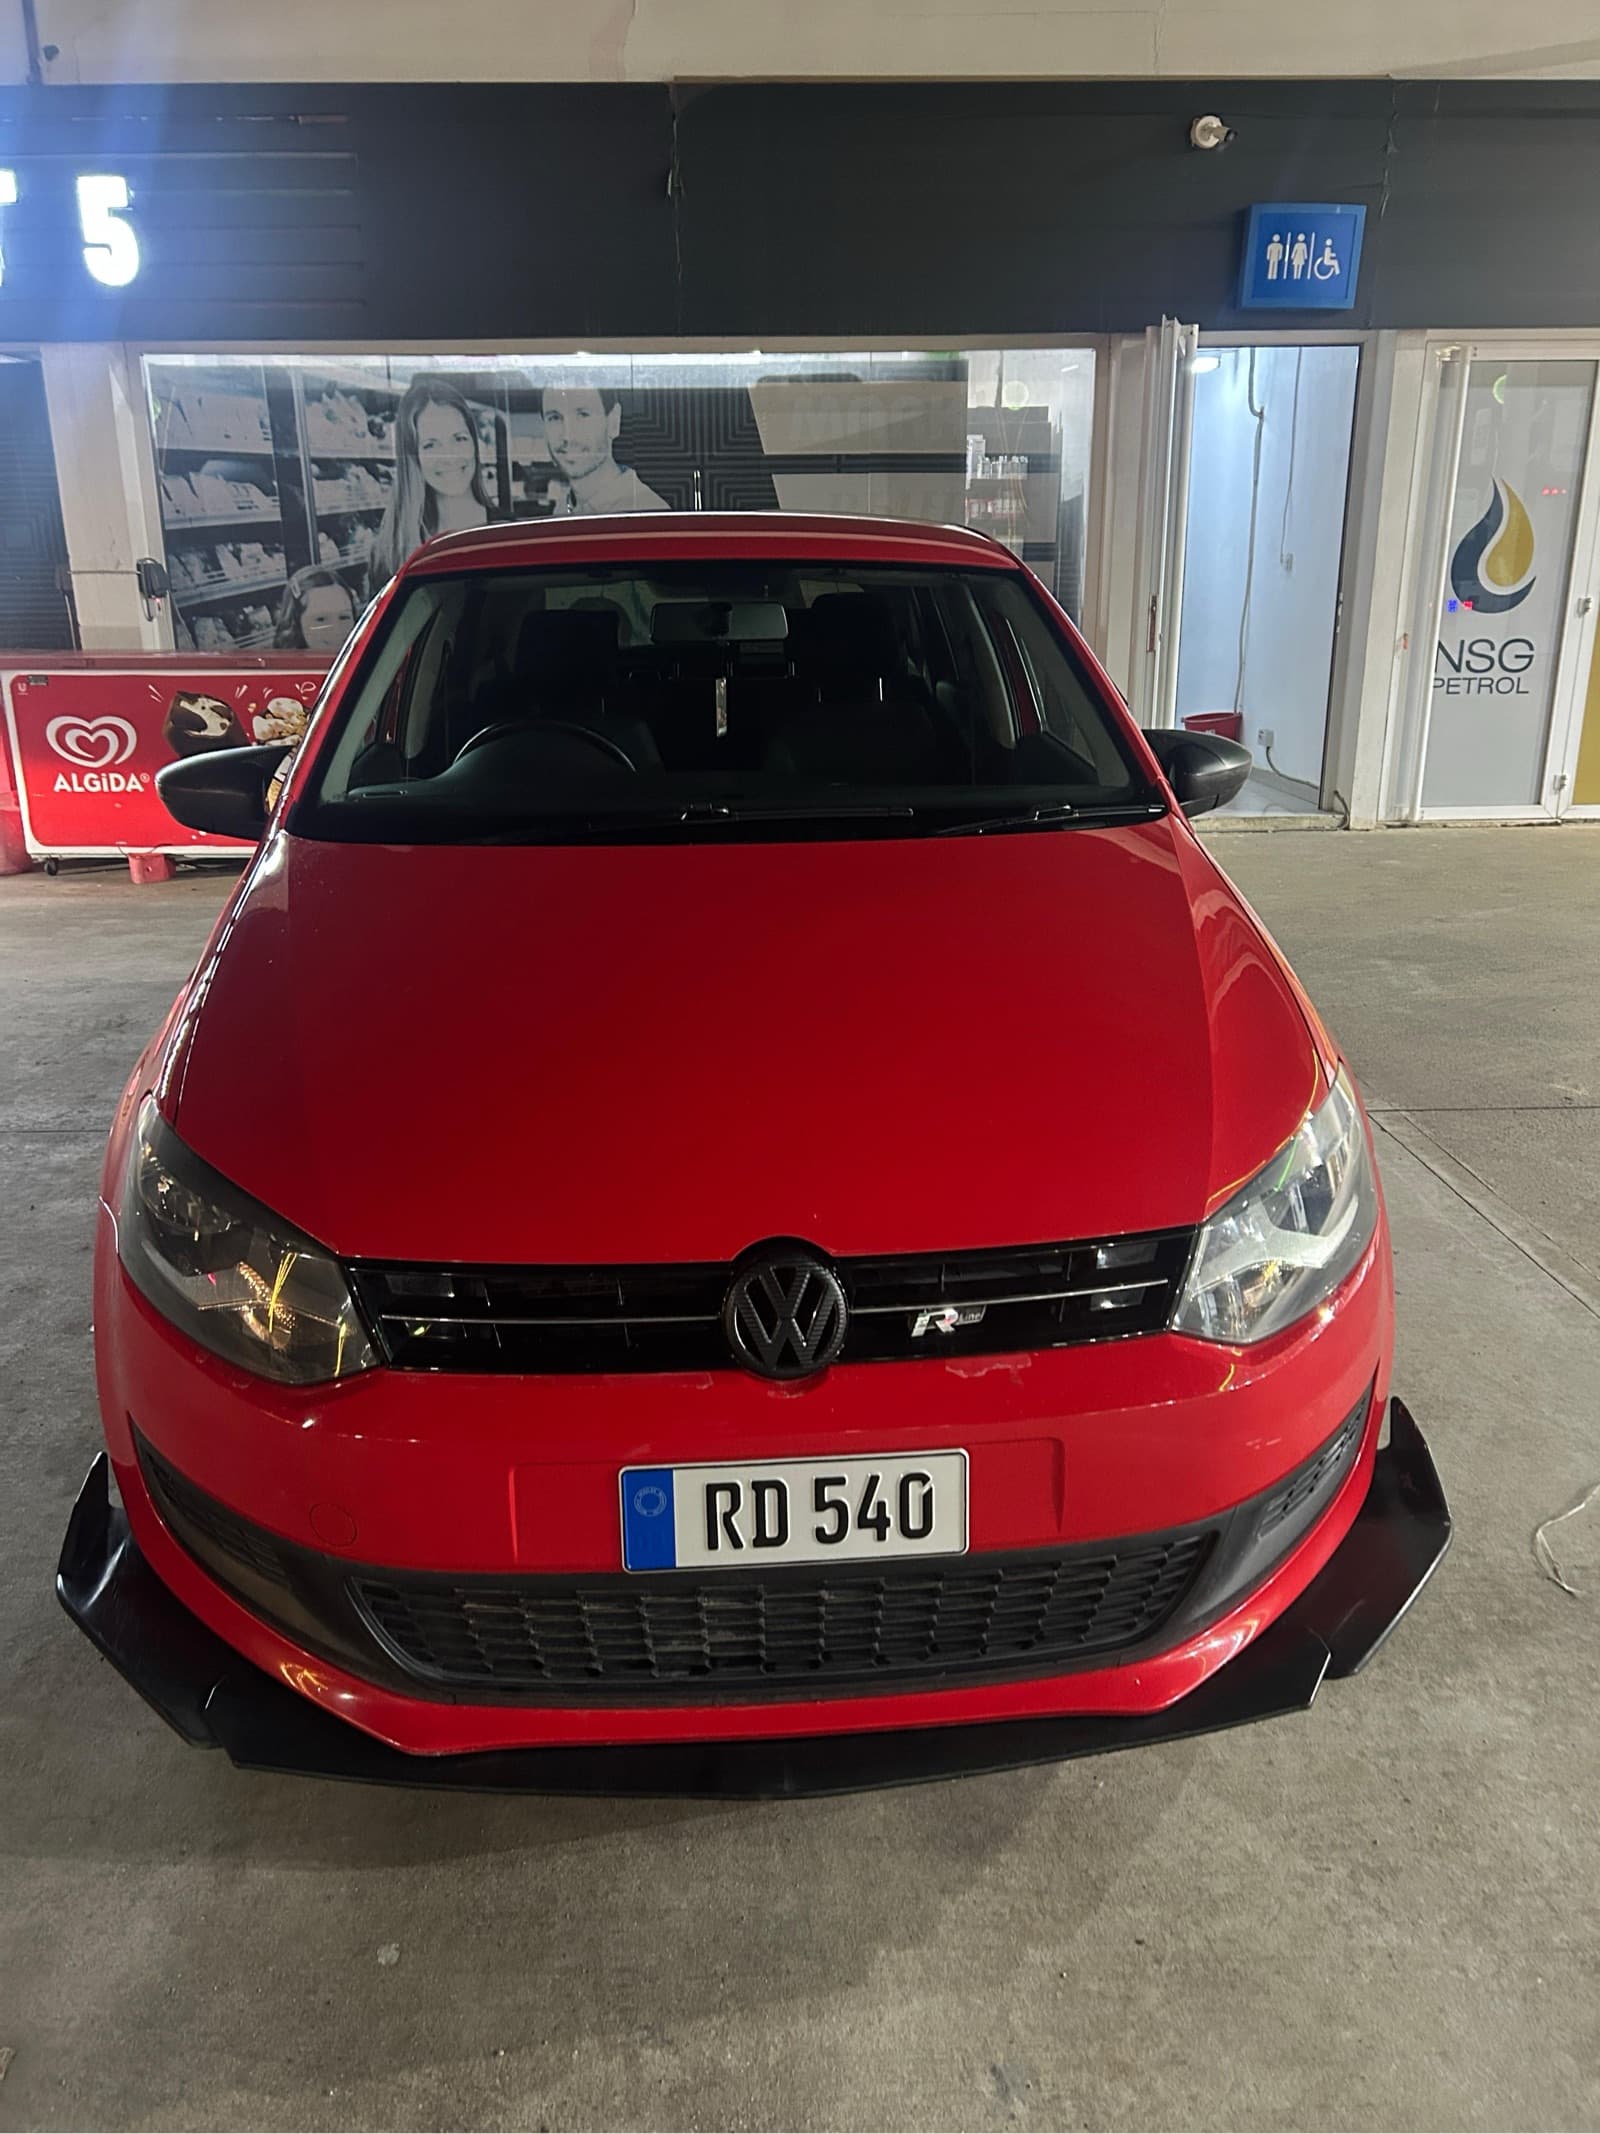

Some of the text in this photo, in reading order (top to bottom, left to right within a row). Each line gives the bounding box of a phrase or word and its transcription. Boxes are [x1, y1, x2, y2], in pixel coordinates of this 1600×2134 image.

[76, 175, 140, 287] 5
[1434, 637, 1535, 674] NSG
[1433, 676, 1530, 696] PETROL
[705, 1472, 934, 1551] RD 540
